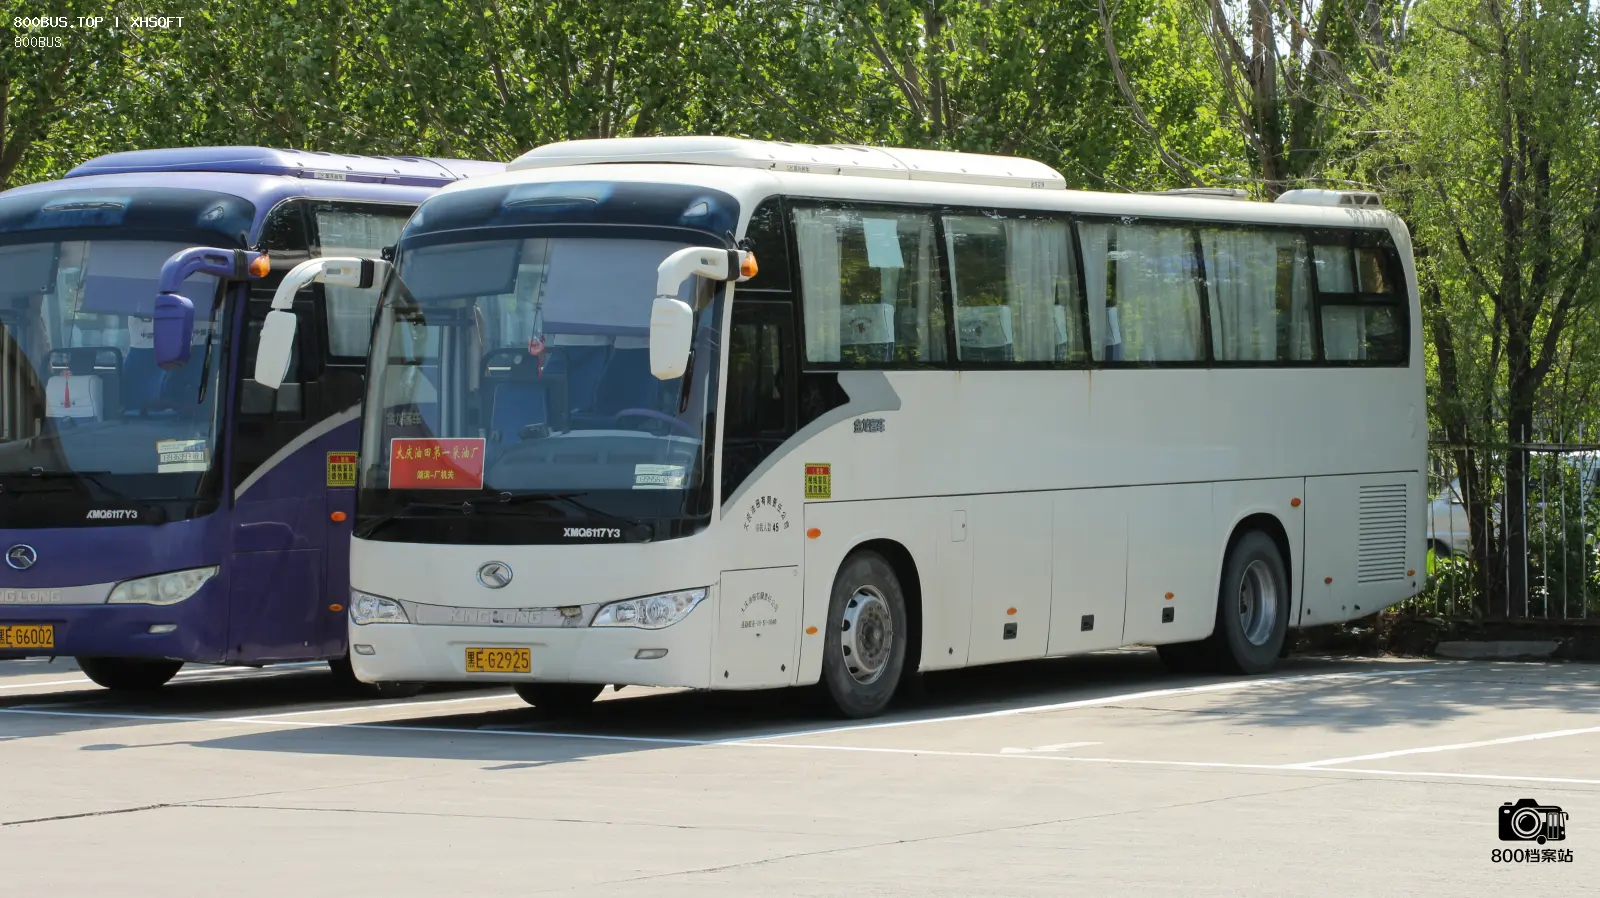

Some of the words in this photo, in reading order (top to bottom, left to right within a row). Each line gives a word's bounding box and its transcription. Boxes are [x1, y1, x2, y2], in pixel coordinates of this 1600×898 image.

[396, 445, 479, 460] 大庆油田第一采油厂
[563, 528, 621, 539] XMQ6117Y3
